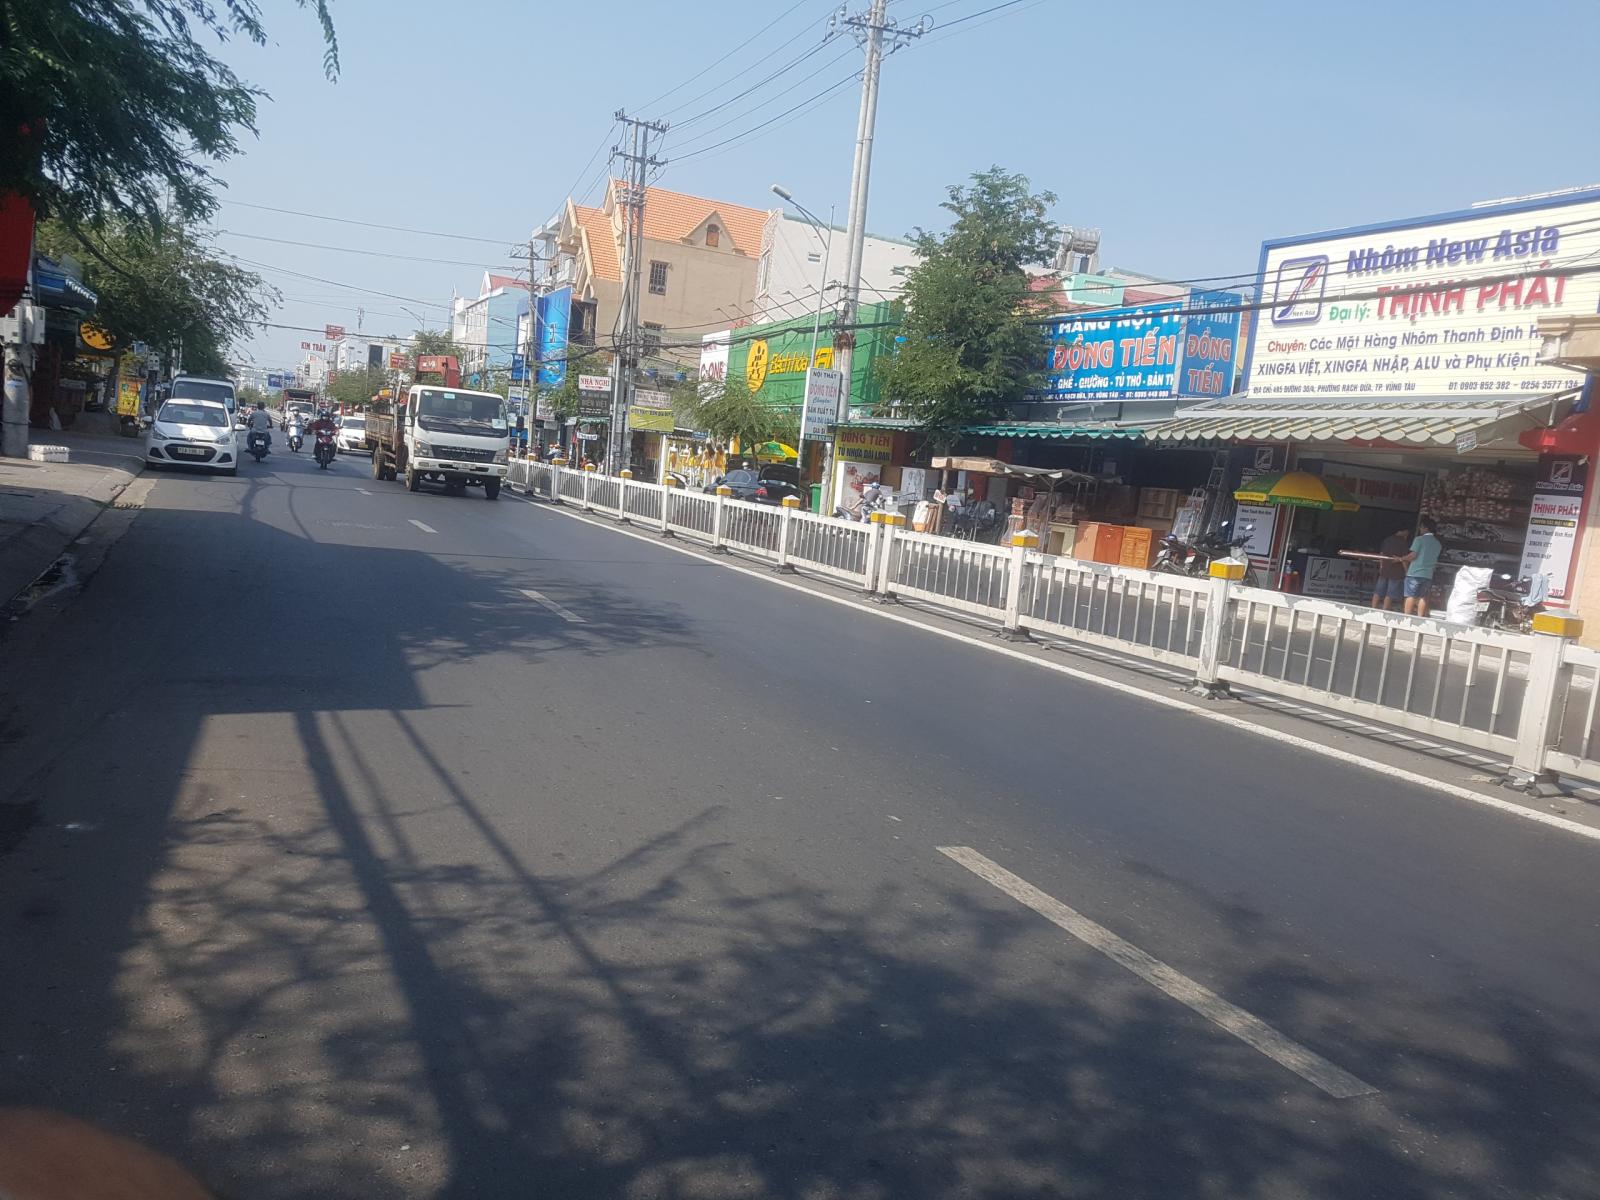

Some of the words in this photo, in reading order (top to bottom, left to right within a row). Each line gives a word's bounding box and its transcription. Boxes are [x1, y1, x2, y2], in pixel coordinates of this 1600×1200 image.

[1347, 244, 1420, 274] Nhôm
[1426, 237, 1489, 265] New
[1493, 225, 1560, 258] Asia
[1377, 278, 1467, 322] THỊNH
[1477, 259, 1567, 310] PHÁT
[1329, 305, 1351, 323] Đại
[1354, 302, 1371, 323] lý:
[1119, 326, 1177, 367] TIẾN
[1267, 339, 1307, 354] Chuyên:
[1309, 337, 1332, 350] Các
[1336, 336, 1359, 351] Mặt
[1364, 333, 1397, 349] Hàng
[1401, 331, 1437, 346] Nhôm
[1443, 329, 1485, 343] Thanh
[1490, 326, 1523, 344] Định
[812, 370, 822, 379] NỘI
[823, 371, 837, 379] THẤT
[1187, 362, 1225, 395] TIẾN
[1257, 362, 1296, 376] XINGFA
[1298, 358, 1321, 377] VIỆT,
[1323, 359, 1368, 374] XINGFA
[1372, 354, 1409, 374] NHẬP,
[1414, 356, 1439, 370] ALU
[1445, 355, 1461, 369] và
[1465, 354, 1492, 371] Phụ
[1495, 352, 1529, 371] Kiện
[1480, 381, 1494, 390] 852
[1496, 381, 1511, 390] 382
[1542, 380, 1561, 390] 3577
